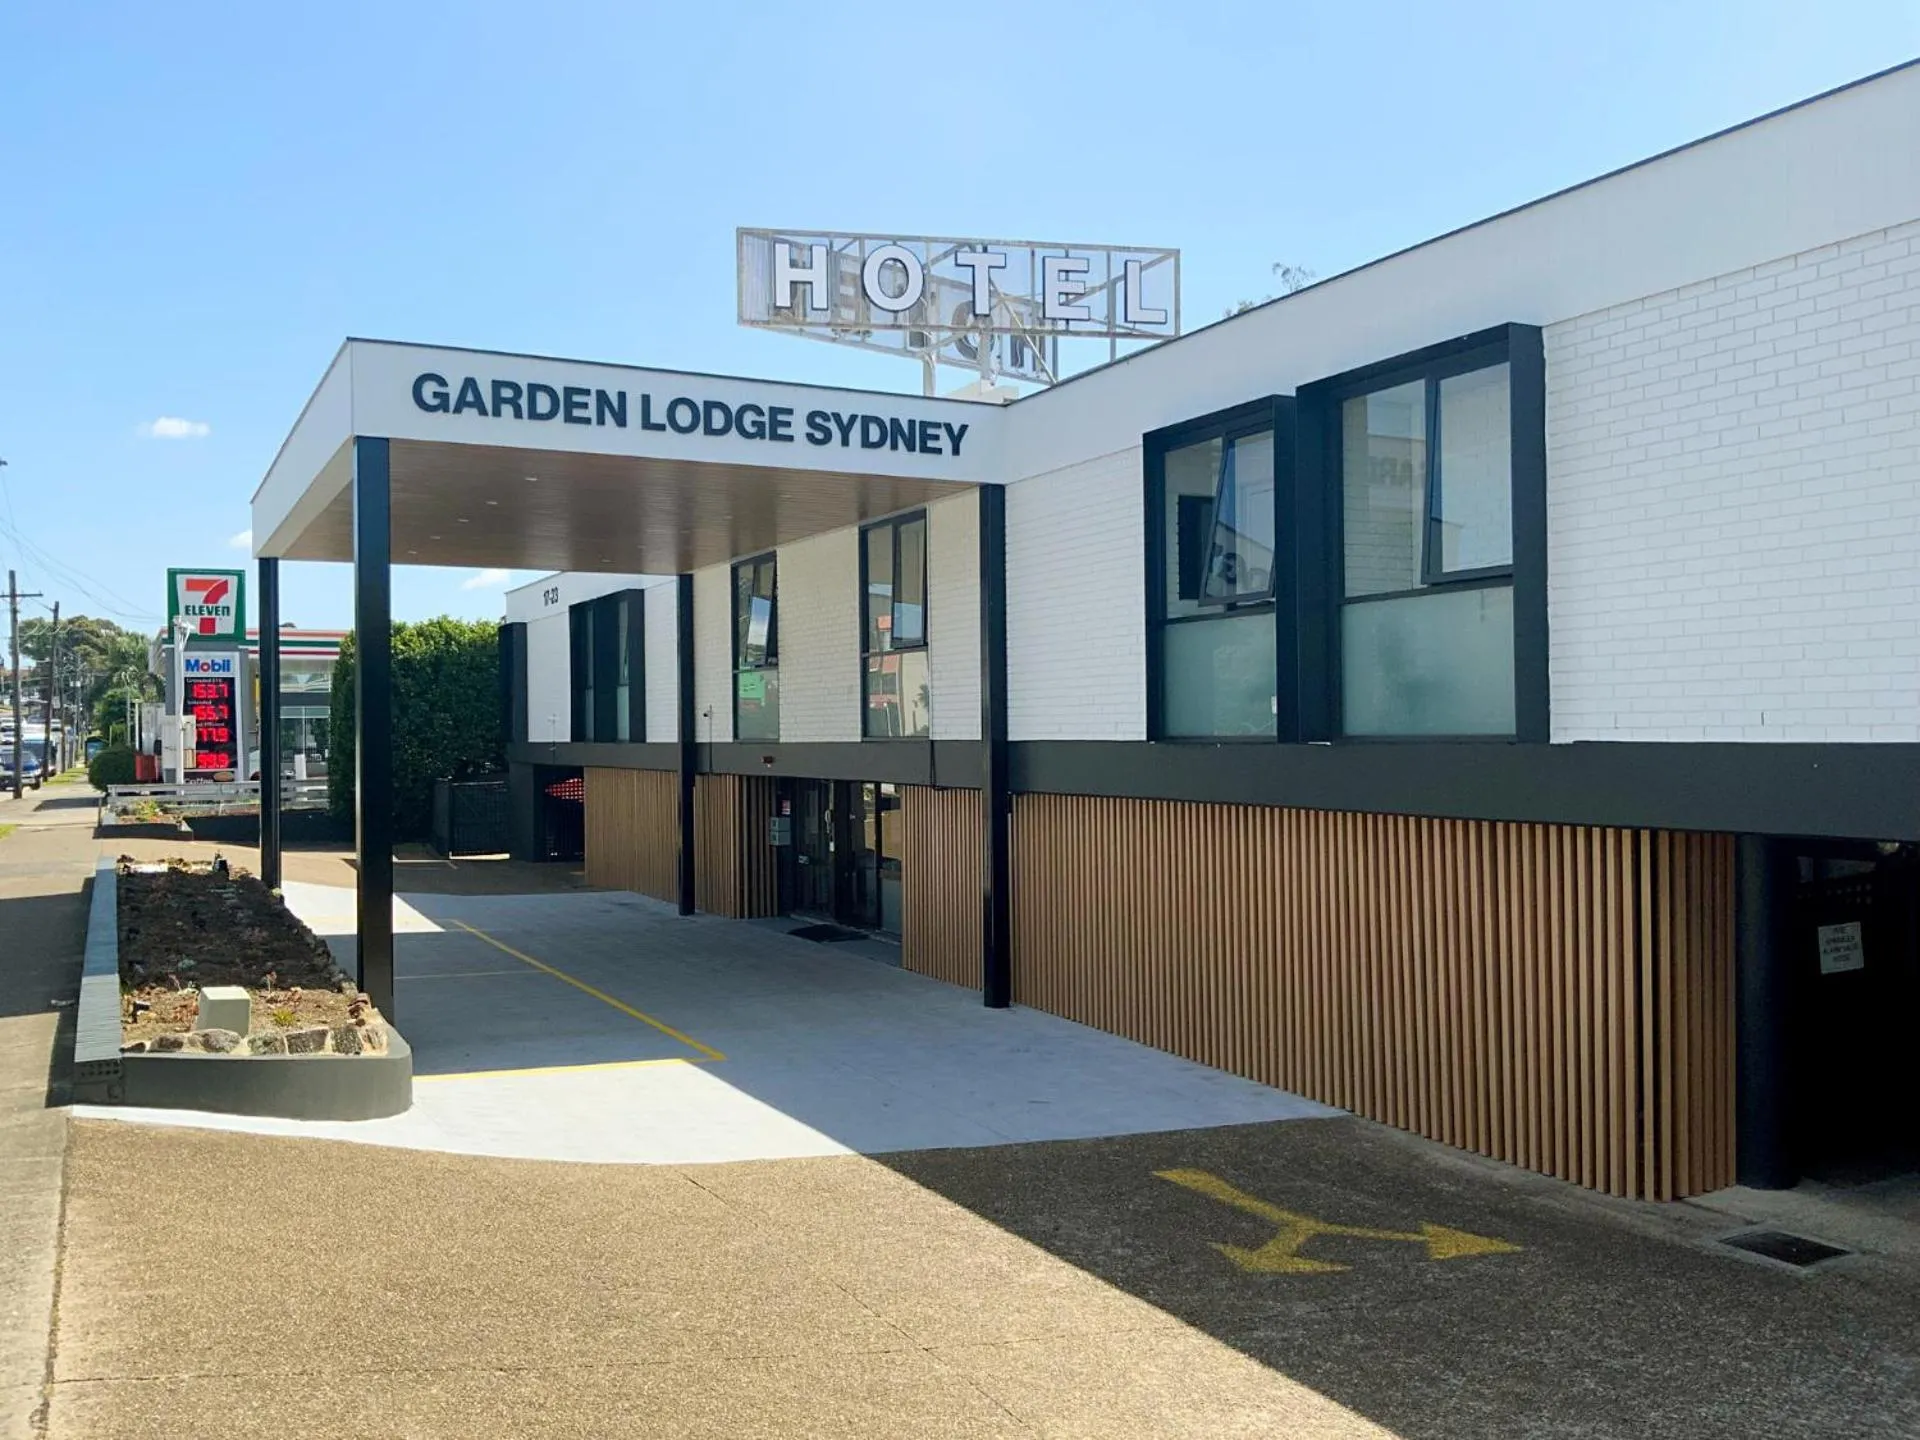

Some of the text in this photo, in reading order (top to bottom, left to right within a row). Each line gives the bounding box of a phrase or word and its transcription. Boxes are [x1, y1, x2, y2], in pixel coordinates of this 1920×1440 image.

[773, 241, 1168, 324] HOTEL
[411, 372, 969, 457] GARDEN LODGE SYDNEY
[185, 579, 228, 634] 7
[185, 658, 231, 673] Mobil
